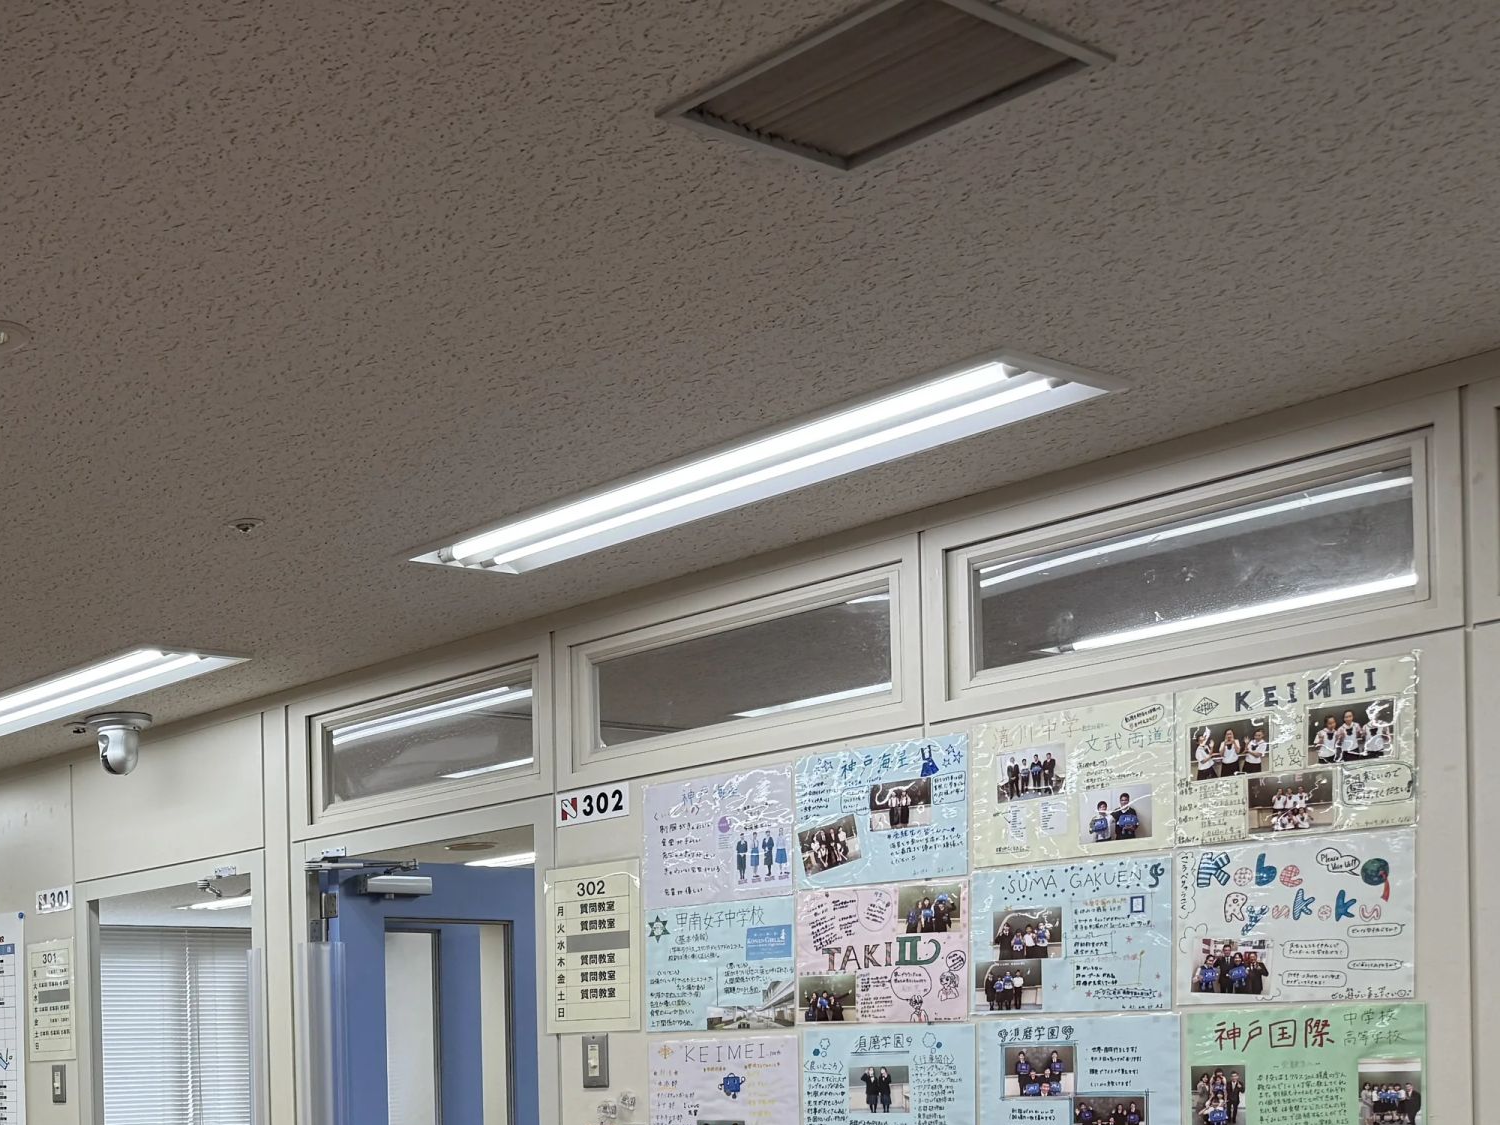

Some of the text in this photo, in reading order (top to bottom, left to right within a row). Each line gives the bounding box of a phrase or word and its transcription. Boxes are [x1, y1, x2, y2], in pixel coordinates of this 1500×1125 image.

[1235, 667, 1377, 712] KEIMEI
[841, 751, 909, 779] 神戸海星
[582, 789, 624, 816] 302
[1197, 852, 1303, 888] Kobe
[577, 880, 606, 897] 302
[1008, 869, 1142, 894] SUMA GAKUEN
[50, 889, 69, 908] 301
[557, 901, 616, 917] 月 質問教室
[675, 906, 765, 931] 甲南女子中学校
[1223, 888, 1382, 936] Ryukoku
[557, 918, 616, 934] 火 質問教室
[557, 940, 565, 951] 水
[42, 953, 57, 964] 301
[557, 953, 616, 968] 木 質問教室
[557, 970, 616, 985] 金 質問教室
[557, 987, 616, 1002] 土 質問教室
[557, 1008, 565, 1019] 日
[1343, 1008, 1398, 1027] 中学校
[854, 1033, 904, 1052] 須磨学園
[1009, 1026, 1059, 1041] 須磨学園
[1214, 1018, 1335, 1052] 神戸国際
[1343, 1030, 1406, 1047] 高等学校
[684, 1043, 765, 1063] KEIMEI
